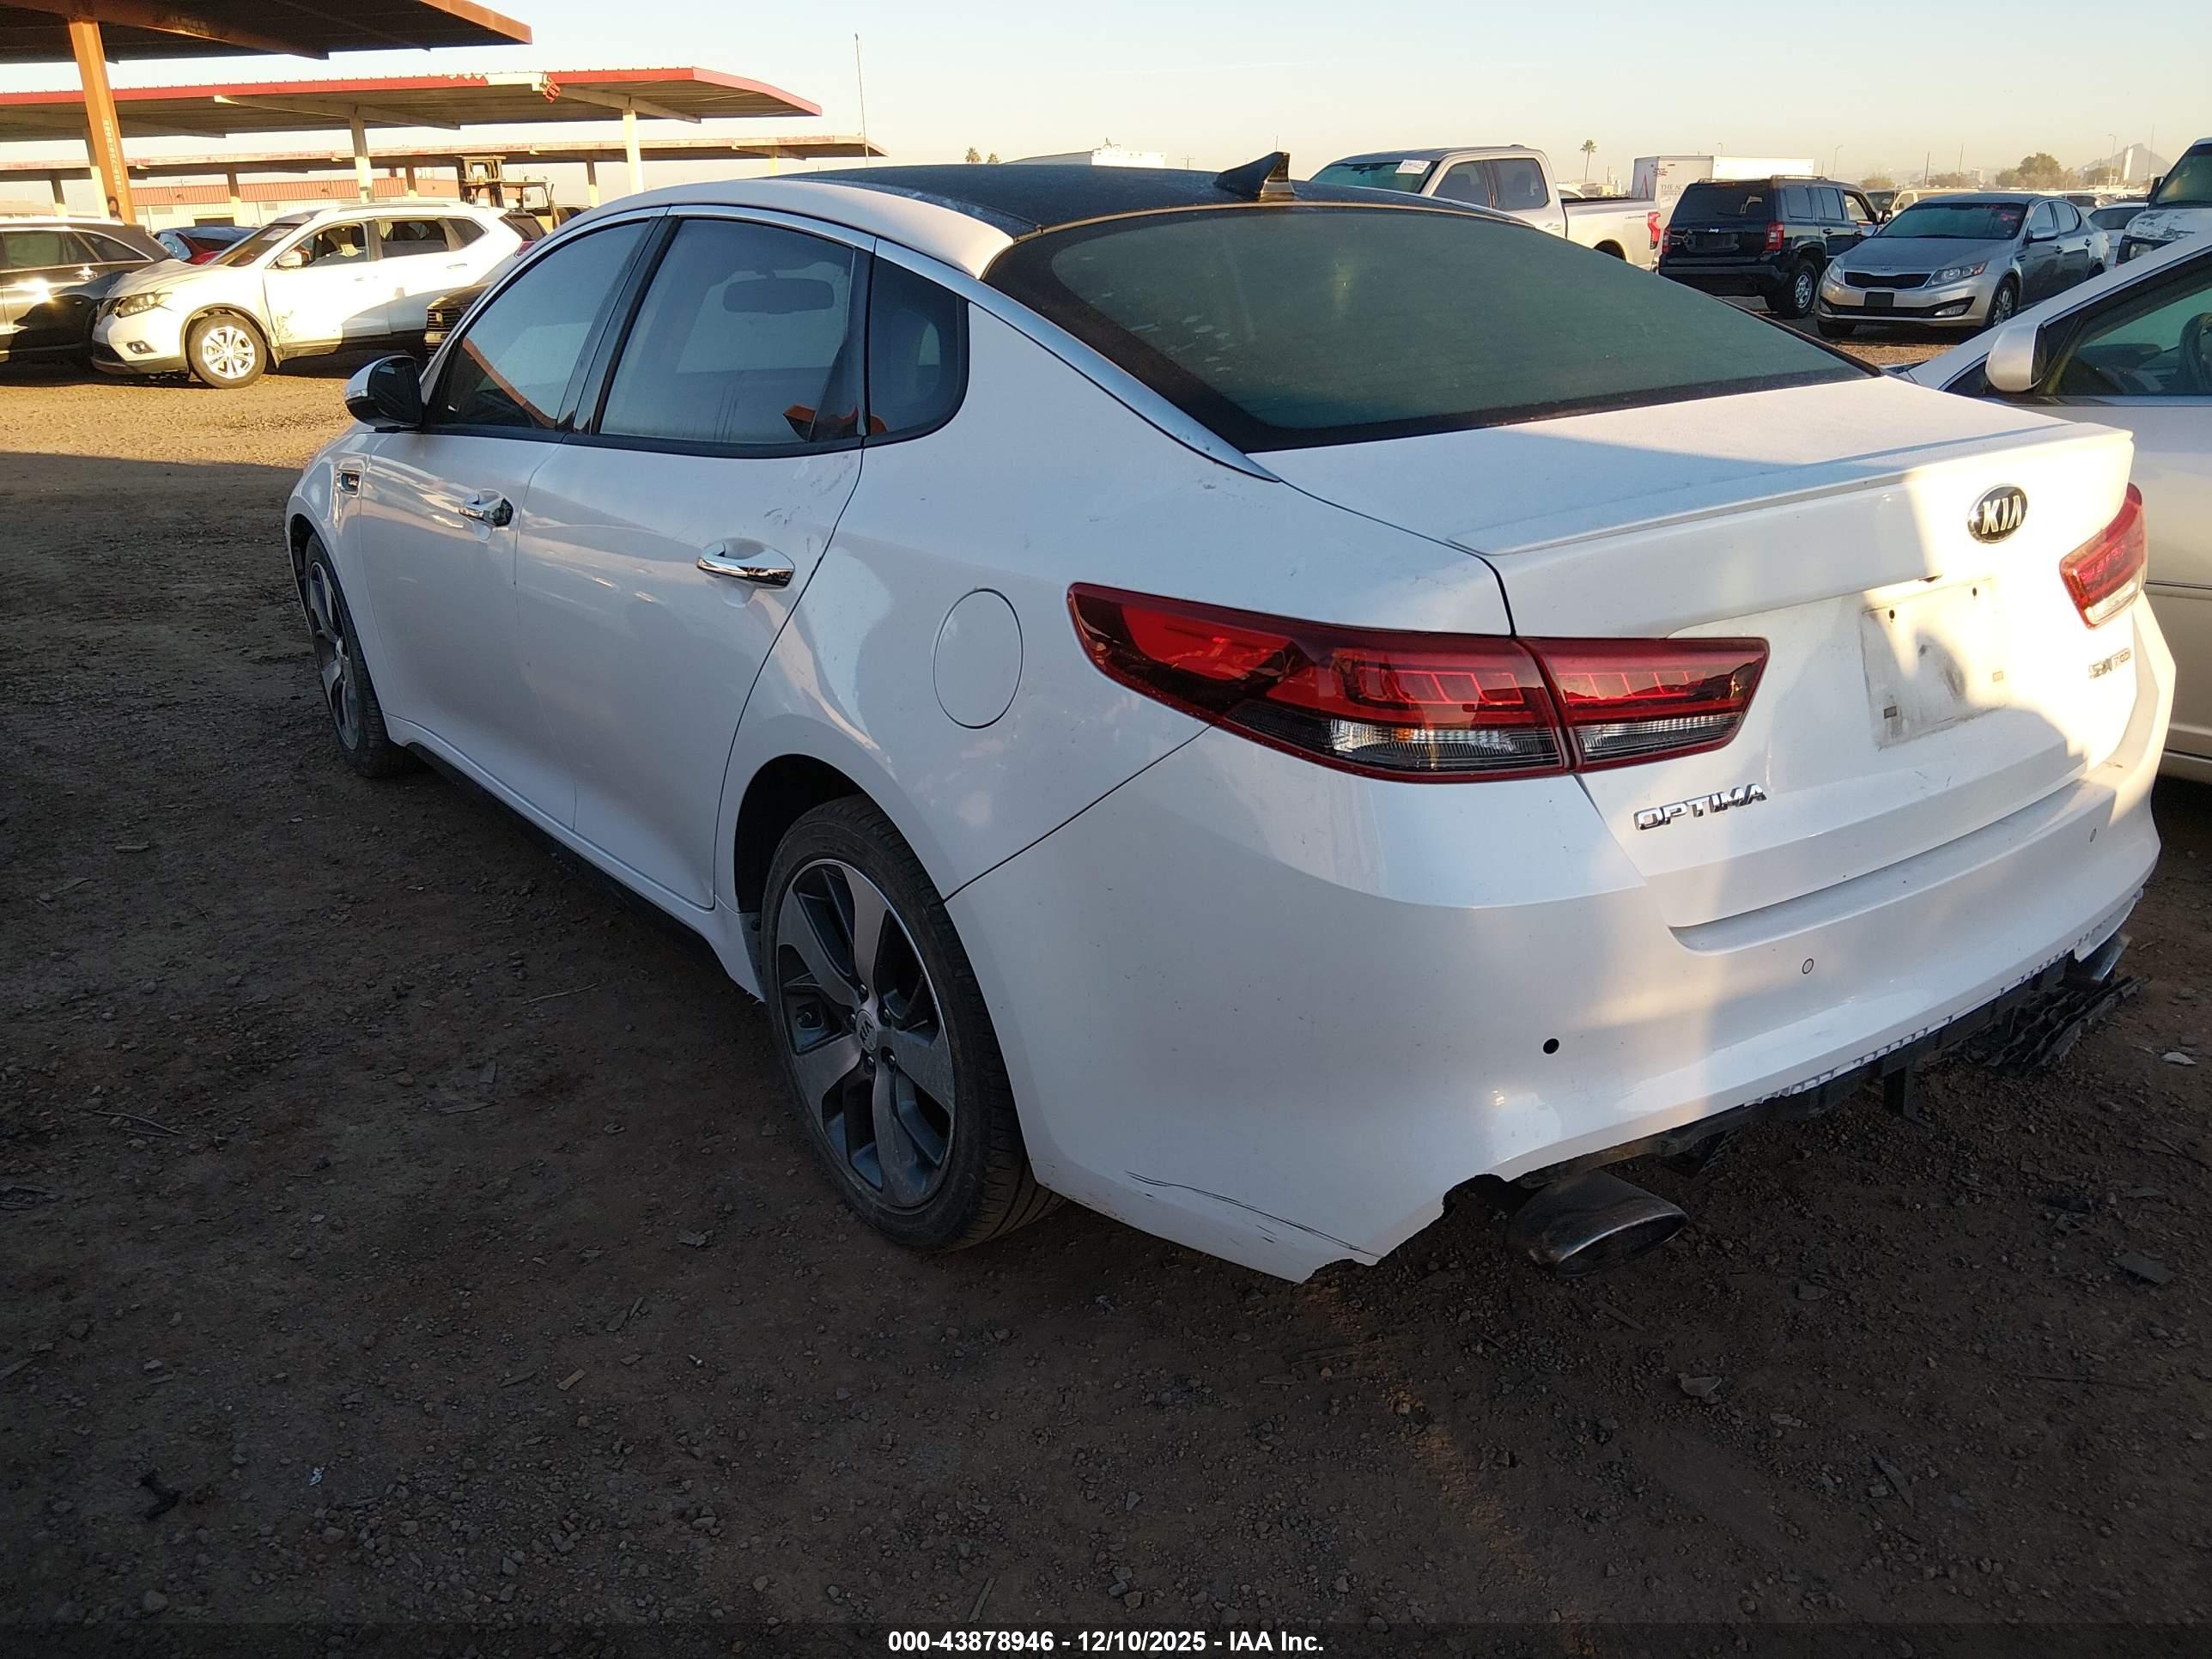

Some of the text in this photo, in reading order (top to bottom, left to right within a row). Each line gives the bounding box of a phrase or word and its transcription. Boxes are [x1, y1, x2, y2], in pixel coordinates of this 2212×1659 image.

[1981, 495, 2022, 535] KIA
[1634, 783, 1768, 830] OPTIMA
[859, 1020, 873, 1045] KIA
